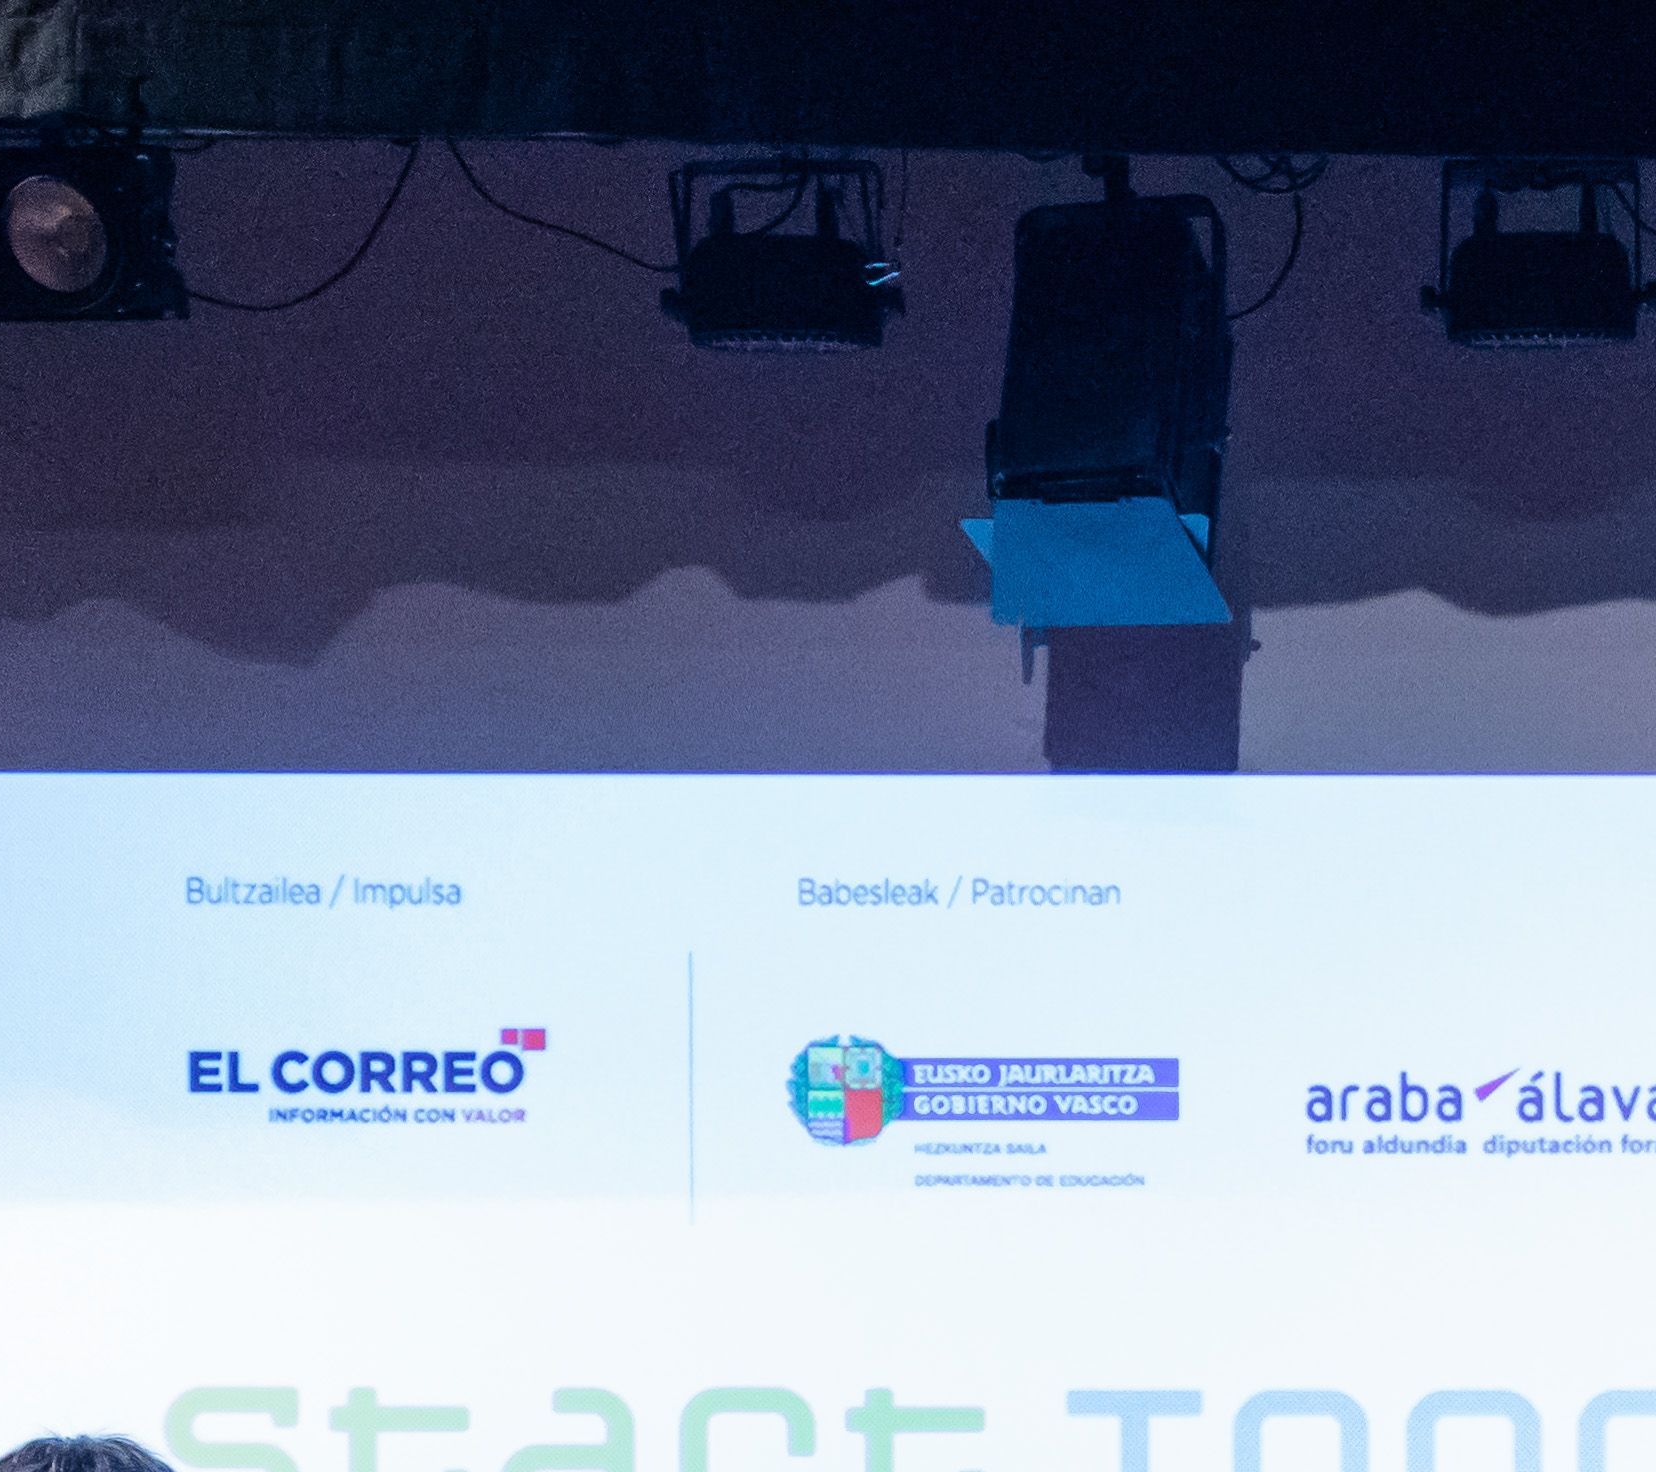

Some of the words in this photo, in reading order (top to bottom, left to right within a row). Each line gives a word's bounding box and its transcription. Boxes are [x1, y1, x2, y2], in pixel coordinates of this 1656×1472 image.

[186, 876, 321, 906] Bultzailea
[328, 874, 347, 909] /
[354, 877, 462, 909] Impulsa
[798, 877, 939, 906] Babesleak
[947, 874, 964, 909] /
[972, 877, 1121, 906] Patrocinan
[189, 1051, 260, 1093] EL
[271, 1050, 525, 1094] CORREO
[913, 1064, 991, 1085] EUSKO
[999, 1064, 1156, 1085] JAURLARITZA
[913, 1094, 1047, 1116] GOBIERNO
[1054, 1094, 1139, 1116] VASCO
[1306, 1071, 1463, 1123] araba
[270, 1106, 407, 1123] INFORMACIÓN
[414, 1108, 456, 1123] CON
[462, 1109, 526, 1123] VALOR
[1363, 1135, 1467, 1154] aldundia
[1483, 1135, 1612, 1158] diputación
